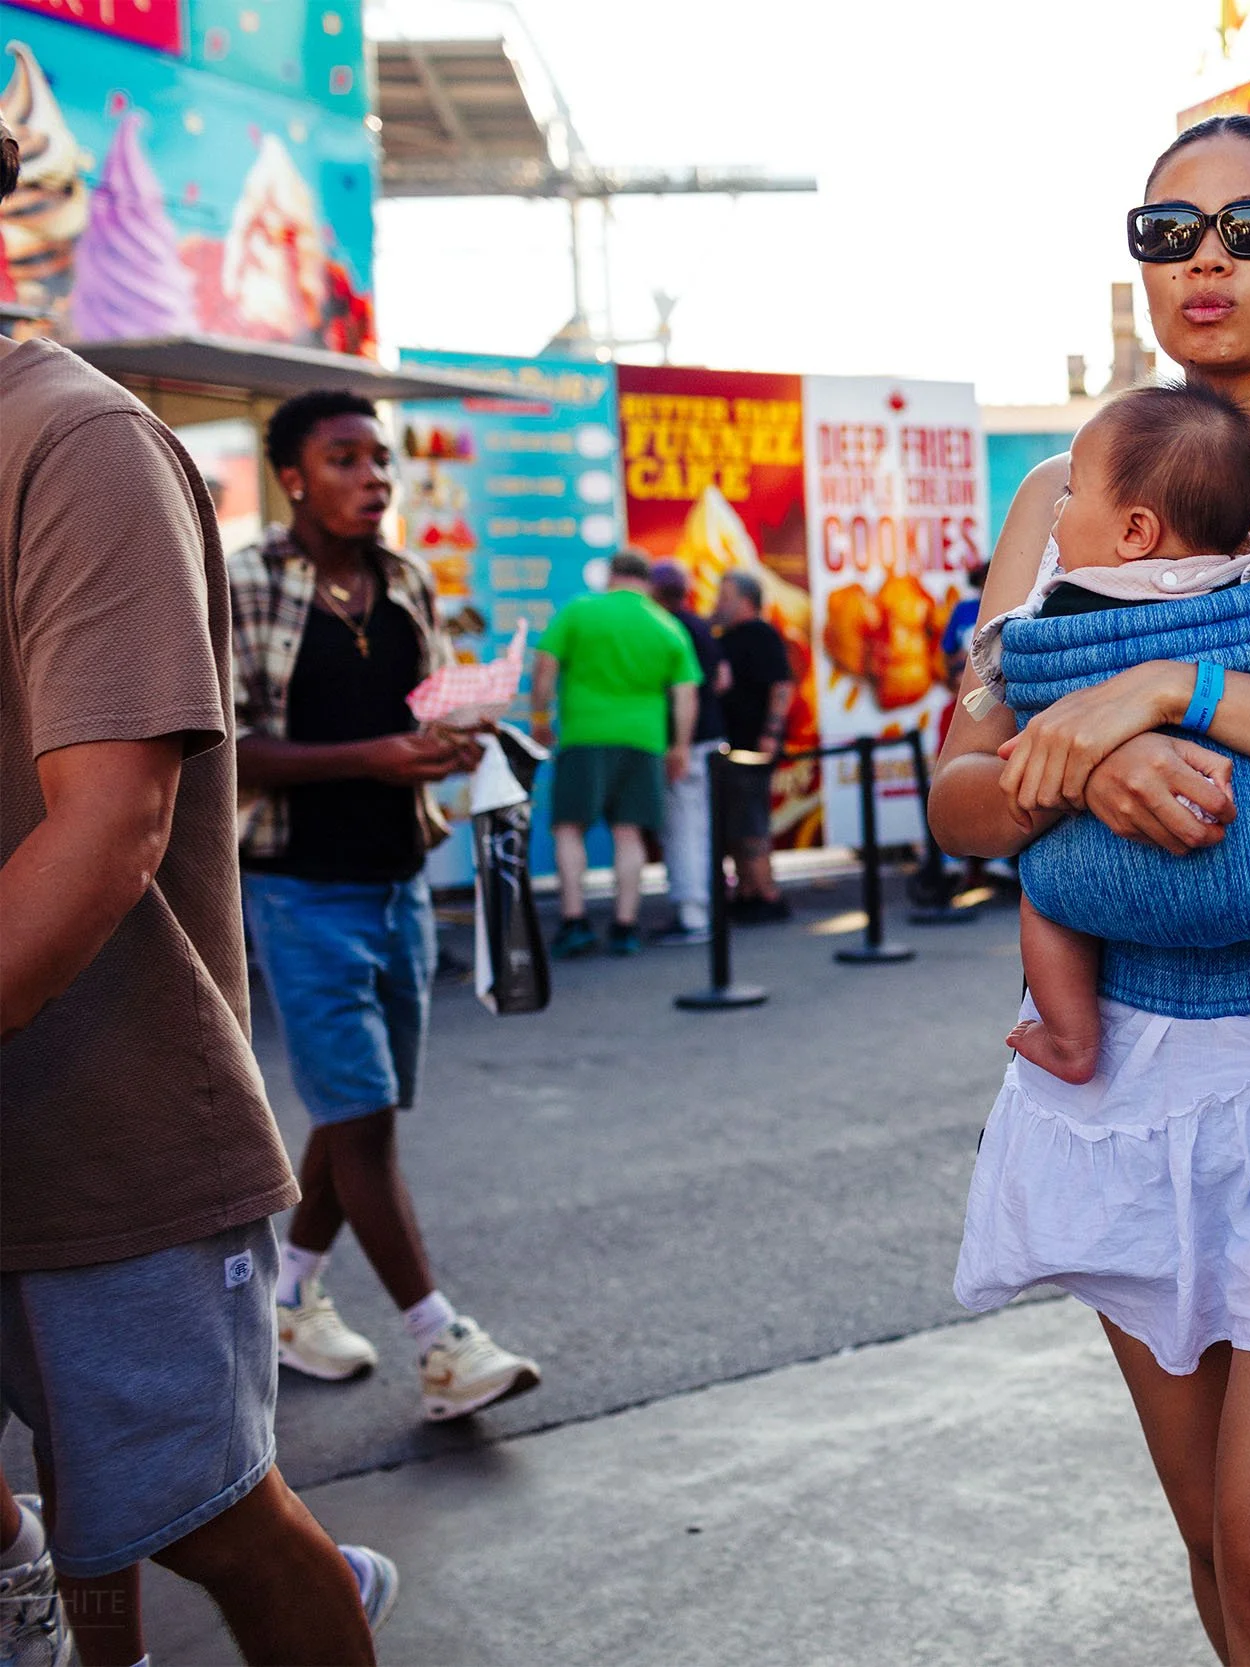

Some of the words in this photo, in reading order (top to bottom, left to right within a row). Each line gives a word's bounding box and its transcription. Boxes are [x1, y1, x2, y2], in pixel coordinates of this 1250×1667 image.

[625, 420, 801, 464] FUNNEL
[820, 424, 885, 468] DEEP
[903, 427, 974, 470] FRIED
[628, 456, 748, 500] CAKE
[823, 516, 981, 573] COOKIES
